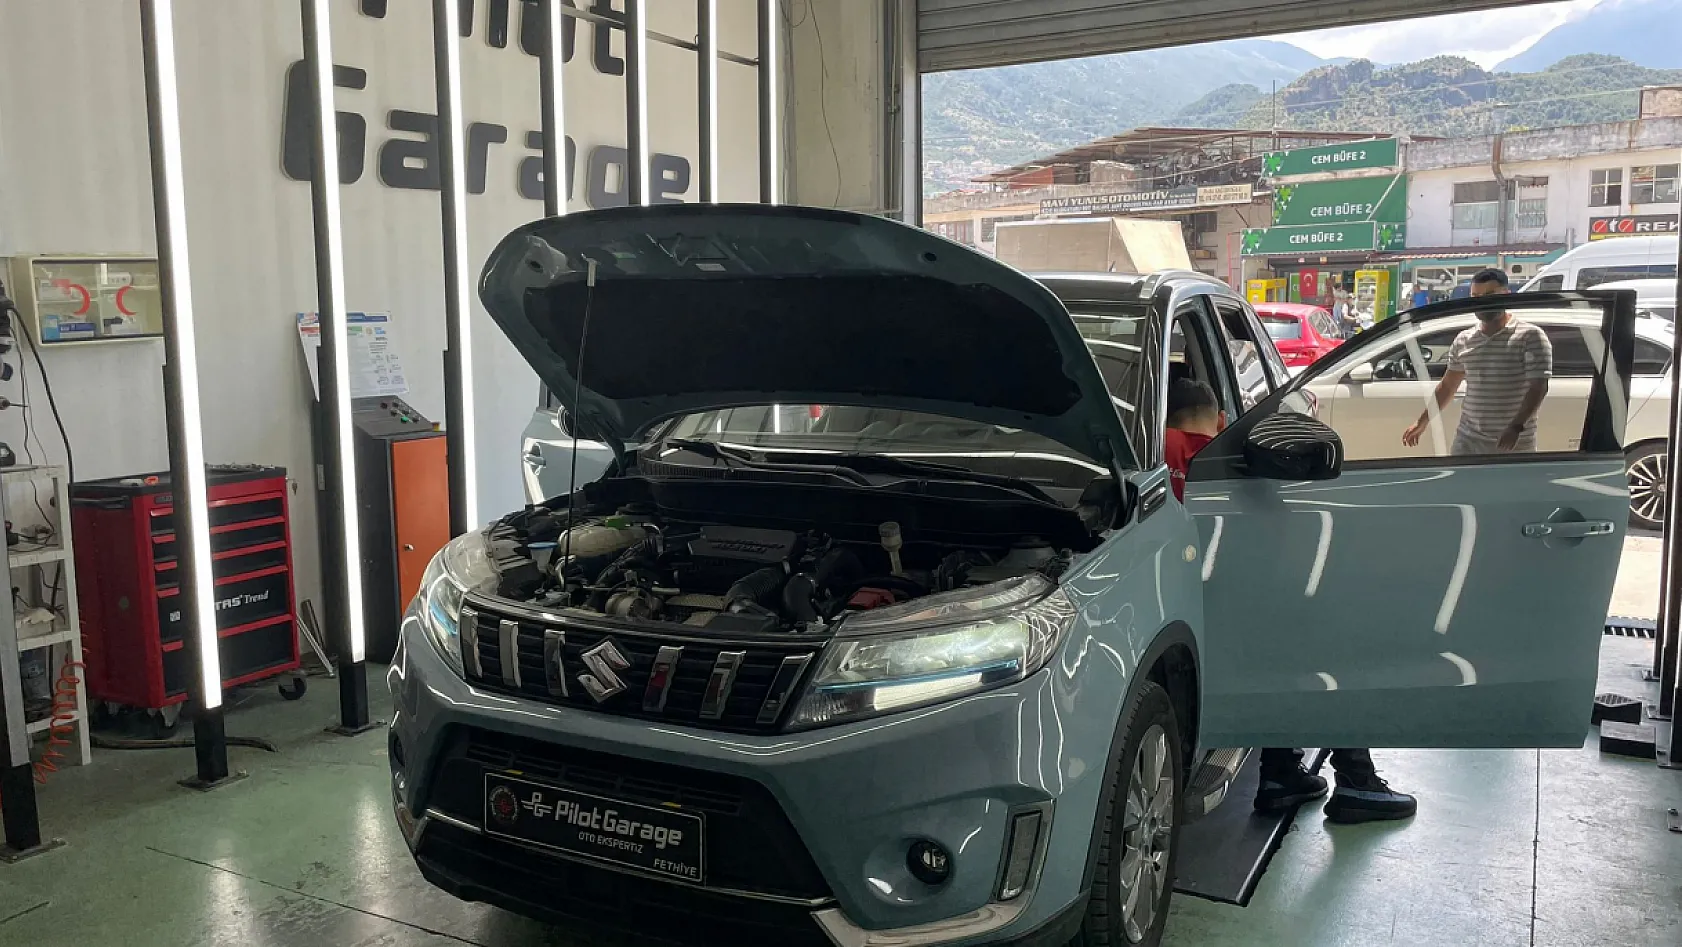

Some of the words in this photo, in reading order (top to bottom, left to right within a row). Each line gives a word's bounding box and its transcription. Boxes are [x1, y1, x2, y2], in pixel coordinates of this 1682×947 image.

[1311, 155, 1331, 165] CEM
[1333, 151, 1358, 162] BÜFE
[1359, 151, 1366, 160] 2
[1310, 206, 1332, 217] CEM
[1335, 203, 1363, 216] BÜFE
[1365, 204, 1372, 213] 2
[1290, 235, 1309, 244] CEM
[1311, 232, 1335, 243] BÜFE
[1336, 233, 1343, 241] 2
[578, 831, 596, 843] OTO
[653, 858, 697, 877] FETHİYE
